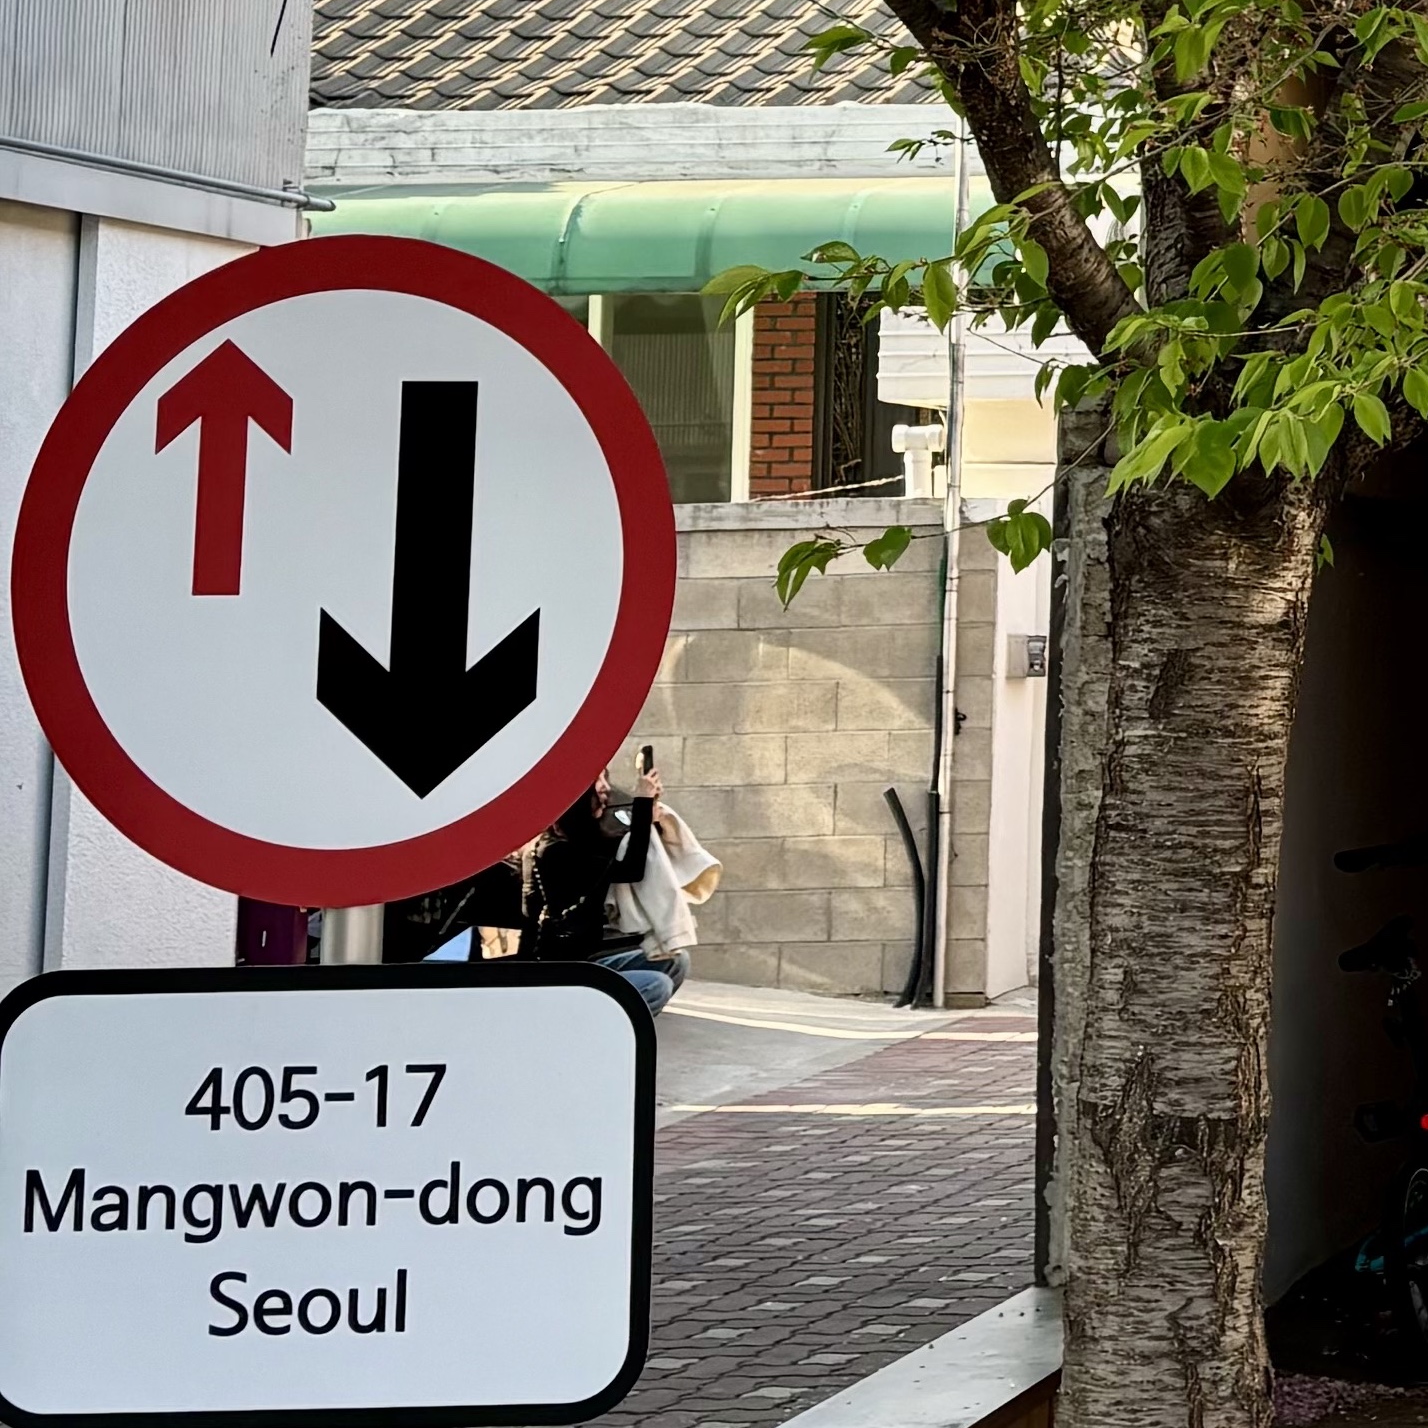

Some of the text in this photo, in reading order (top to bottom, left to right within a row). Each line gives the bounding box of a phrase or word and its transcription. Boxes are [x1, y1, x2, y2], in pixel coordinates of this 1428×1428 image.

[184, 1062, 448, 1132] 405-17
[22, 1160, 604, 1244] Mangwon-dong
[207, 1268, 409, 1337] Seoul
